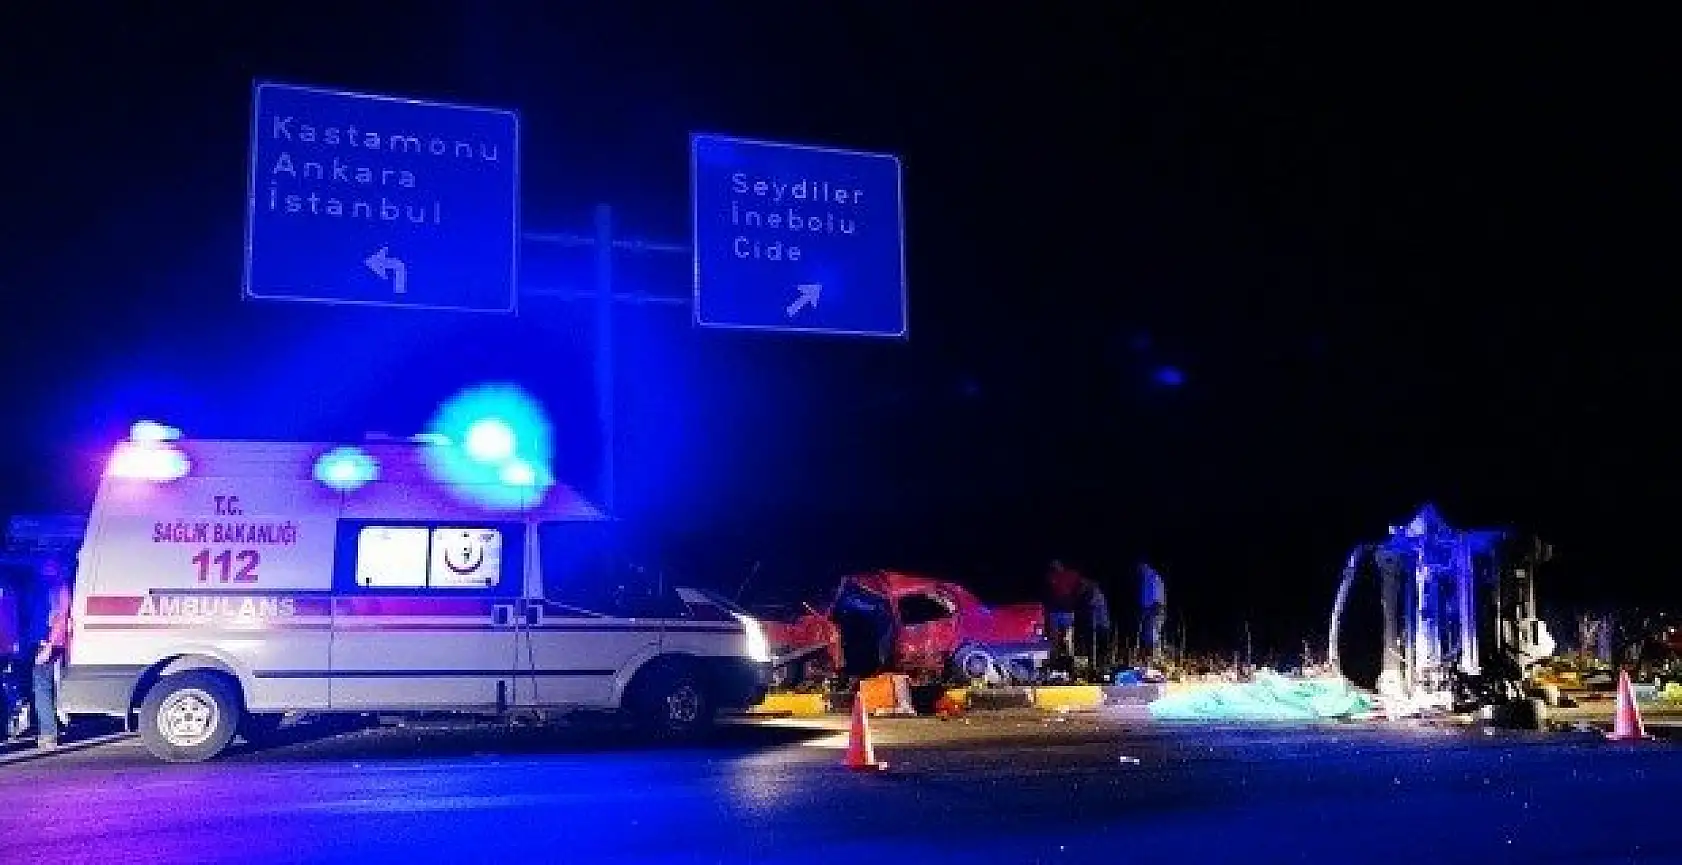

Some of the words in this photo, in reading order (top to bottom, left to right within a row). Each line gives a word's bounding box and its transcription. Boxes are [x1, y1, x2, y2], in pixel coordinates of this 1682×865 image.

[273, 115, 497, 161] Kastamonu
[273, 151, 416, 188] Ankara
[269, 179, 441, 225] İstanbul
[732, 173, 864, 204] Seydiler
[734, 235, 801, 261] Cide
[213, 495, 243, 516] T.C.
[153, 518, 209, 543] SAĞLIK
[192, 549, 261, 584] 112
[138, 596, 294, 618] AMBULANS
